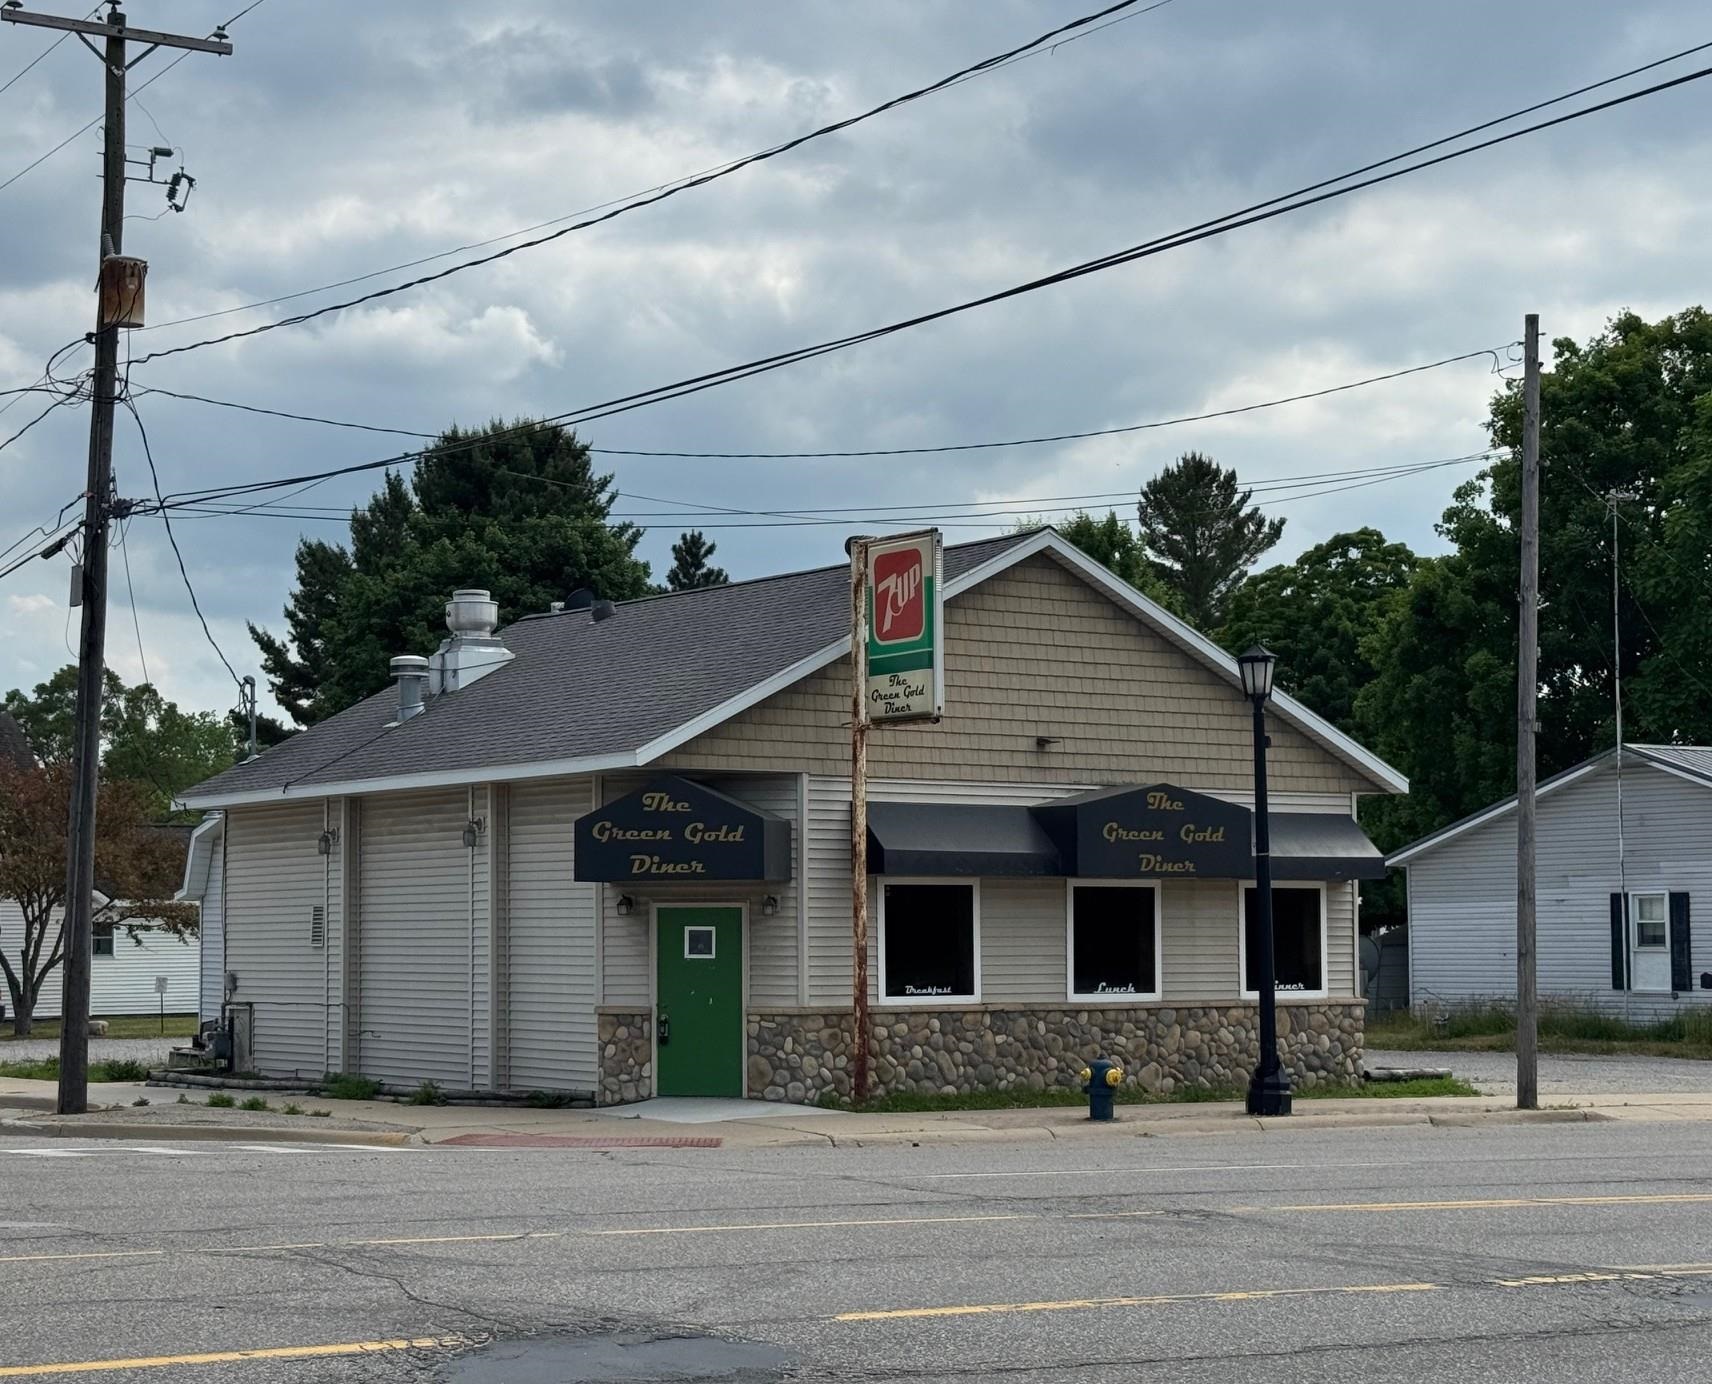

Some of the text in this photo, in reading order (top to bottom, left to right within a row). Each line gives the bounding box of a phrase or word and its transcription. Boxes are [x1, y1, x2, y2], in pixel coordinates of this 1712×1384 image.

[877, 563, 921, 634] 7UP
[889, 674, 908, 688] The
[871, 684, 925, 703] Green Gold
[884, 701, 912, 715] Diner
[642, 792, 692, 812] The
[1146, 792, 1185, 811] The
[592, 821, 744, 844] Green Gold
[1102, 822, 1225, 844] Green Gold
[629, 854, 706, 874] Diner
[1138, 853, 1197, 872] Diner
[905, 985, 952, 995] Breakfast
[1093, 982, 1136, 994] Lunch
[1274, 980, 1305, 991] inner
